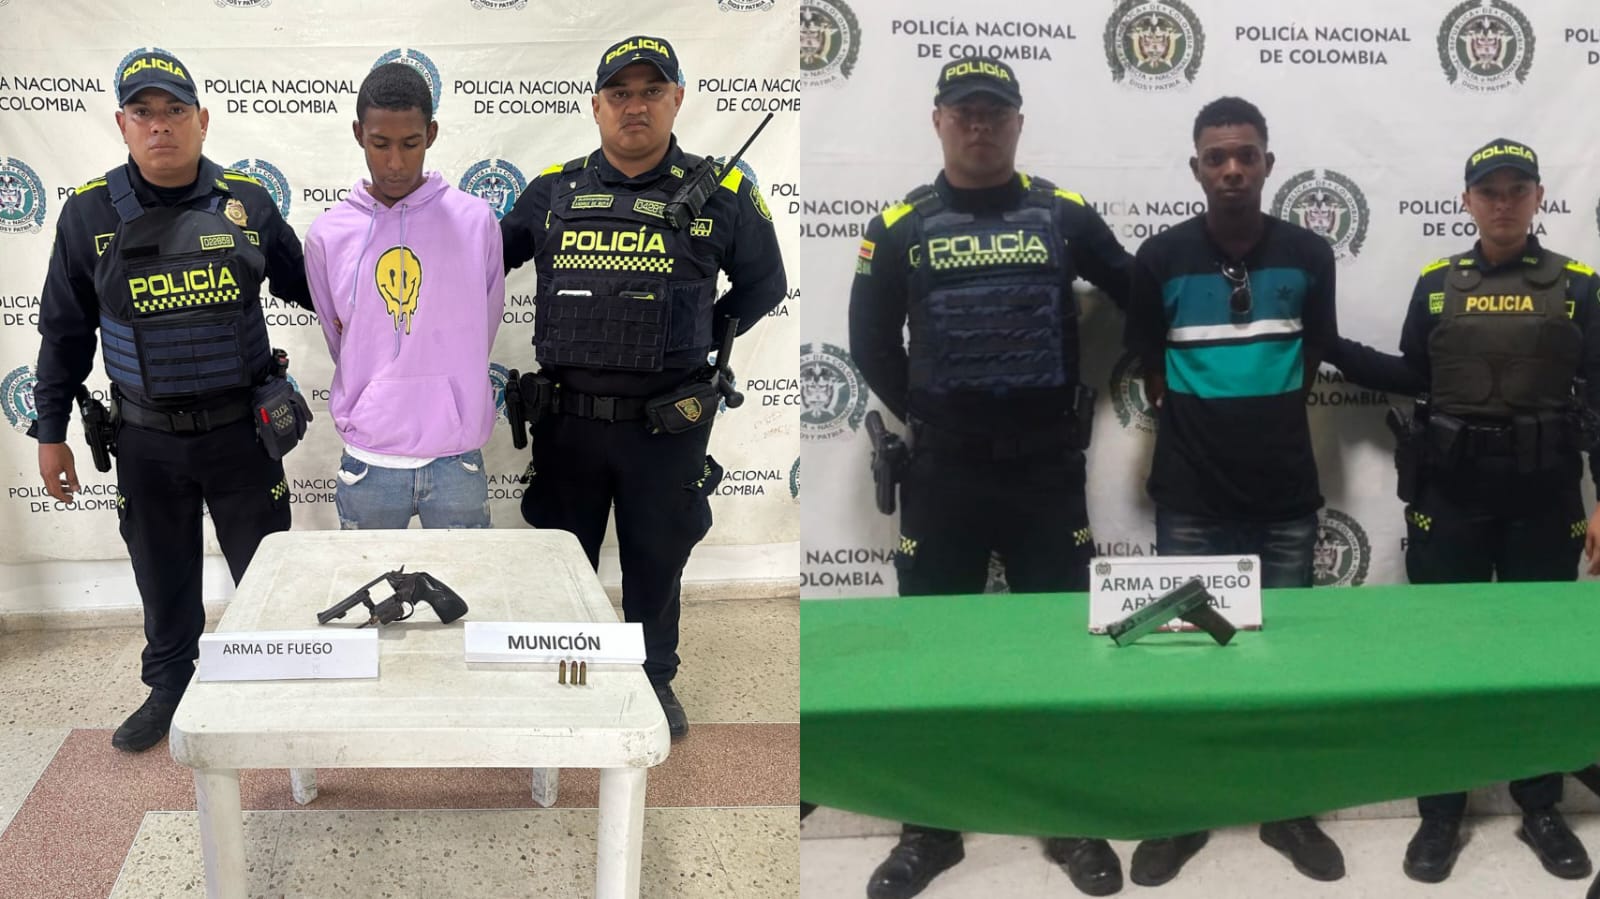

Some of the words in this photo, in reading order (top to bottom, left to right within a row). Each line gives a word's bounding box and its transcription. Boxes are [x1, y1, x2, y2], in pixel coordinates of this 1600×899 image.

[892, 16, 969, 36] POLICÍA
[975, 21, 1077, 40] NACIONAL
[1235, 21, 1309, 42] POLICÍA
[1315, 26, 1411, 43] NACIONAL
[917, 43, 943, 58] DE
[1259, 50, 1284, 65] DE
[1289, 50, 1388, 66] COLOMBIA
[14, 76, 106, 92] NACIONAL
[204, 79, 268, 94] POLICIA
[272, 79, 358, 94] NACIONAL
[454, 80, 514, 95] POLICIA
[519, 80, 597, 95] NACIONA
[698, 78, 757, 93] POLICIA
[0, 96, 87, 112] COLOMBIA
[227, 99, 248, 114] DE
[252, 99, 338, 114] COLOMBIA
[474, 100, 494, 115] DE
[498, 100, 581, 115] COLOMBIA
[716, 98, 738, 112] DE
[303, 188, 352, 202] POLIC
[1422, 222, 1446, 236] DE
[561, 225, 666, 254] POLICÍA
[928, 230, 1048, 262] POLICÍA
[129, 262, 238, 299] POLICÍA
[0, 295, 41, 309] LICIA
[1465, 296, 1534, 313] POLICIA
[3, 313, 25, 326] DE
[747, 378, 799, 391] POLICIA
[762, 394, 779, 407] DE
[722, 470, 783, 481] ACIONAL
[30, 502, 50, 513] DE
[1101, 577, 1154, 592] ARMA
[1189, 575, 1250, 589] UEGO
[223, 642, 263, 655] ARMA
[266, 642, 283, 655] DE
[287, 642, 333, 655] FUEGO
[507, 633, 601, 652] MUNICIÓN
